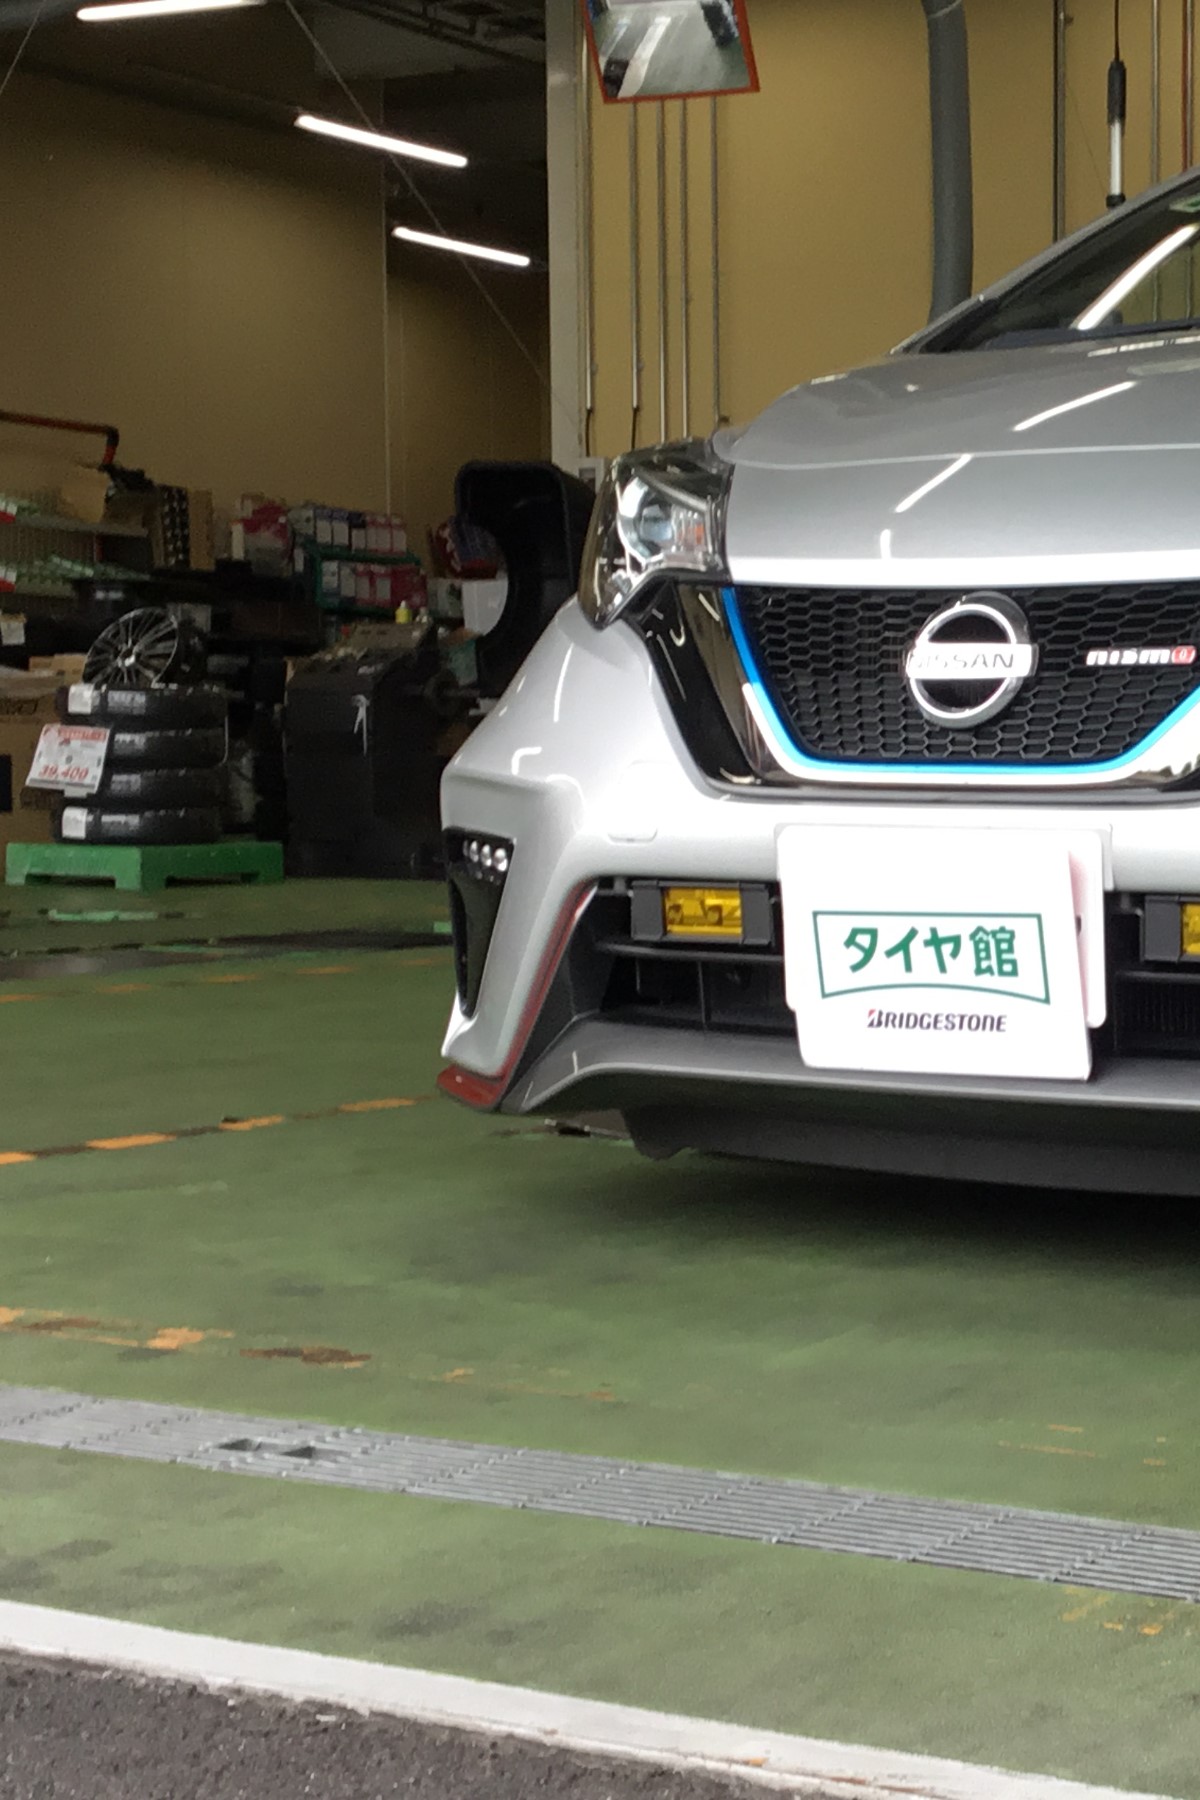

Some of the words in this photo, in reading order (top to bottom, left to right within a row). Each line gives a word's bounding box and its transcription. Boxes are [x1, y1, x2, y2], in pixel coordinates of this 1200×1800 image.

[909, 652, 1014, 671] NISSAN
[843, 926, 1018, 978] タイヤ館
[867, 1009, 1008, 1032] BRIDGESTONE
